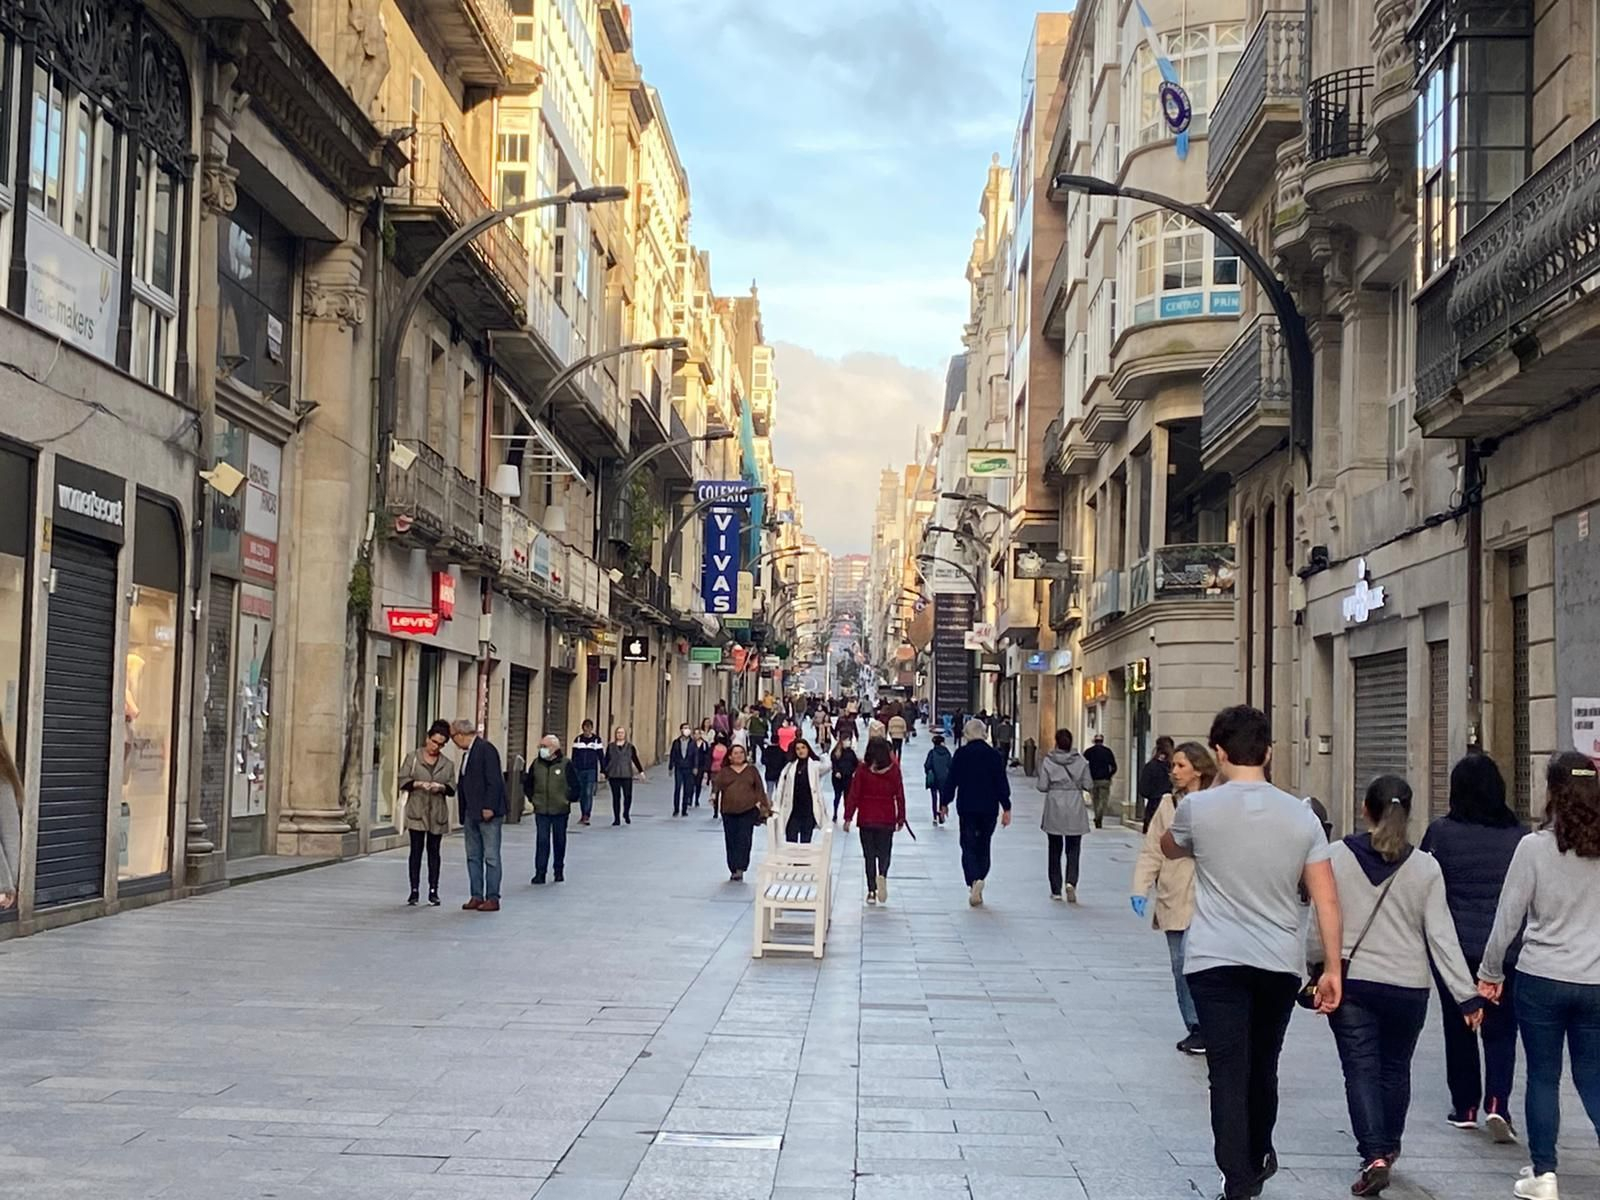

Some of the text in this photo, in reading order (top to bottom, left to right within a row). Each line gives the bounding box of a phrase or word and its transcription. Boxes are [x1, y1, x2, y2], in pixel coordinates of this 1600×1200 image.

[1166, 299, 1200, 312] CENTRO
[698, 485, 748, 503] COLEXIO
[711, 514, 733, 613] VIVAS
